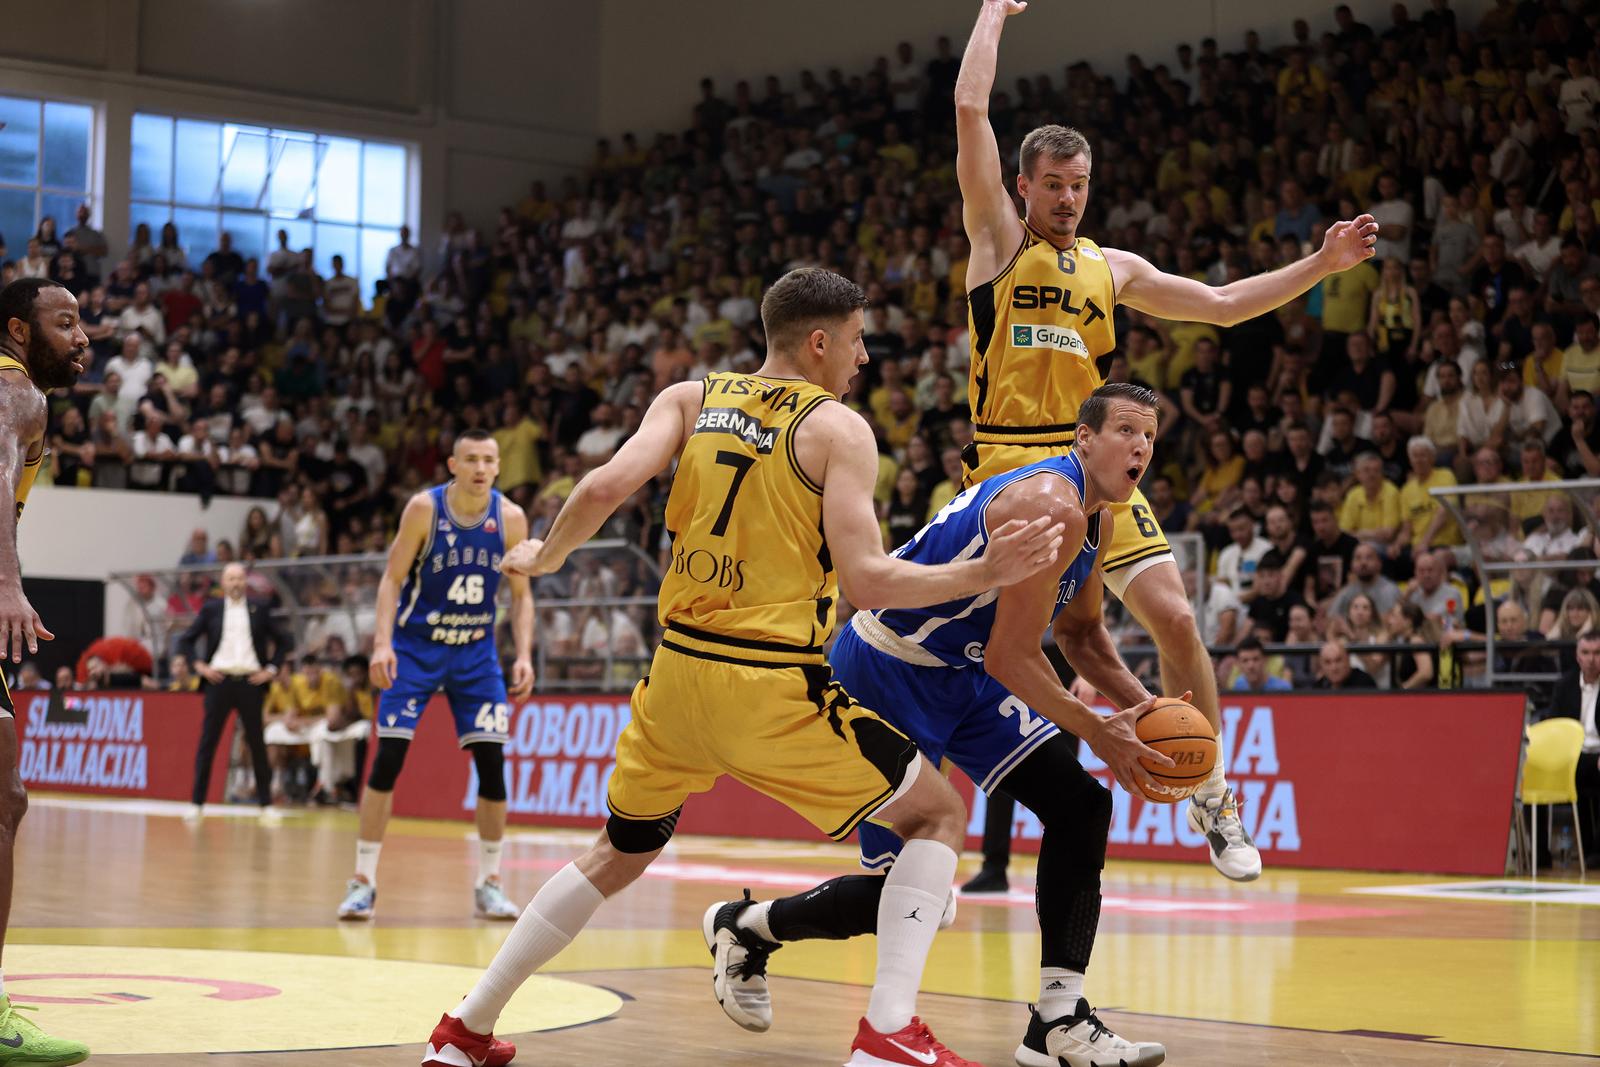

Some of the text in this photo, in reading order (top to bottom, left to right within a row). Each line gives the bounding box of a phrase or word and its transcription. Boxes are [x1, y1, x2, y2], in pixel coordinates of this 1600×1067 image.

[1057, 250, 1076, 275] 6
[1012, 285, 1106, 327] SPLT
[715, 450, 756, 538] 7
[1131, 504, 1159, 538] 6
[675, 545, 748, 593] BOBS
[447, 573, 486, 606] 46
[475, 703, 510, 733] 46
